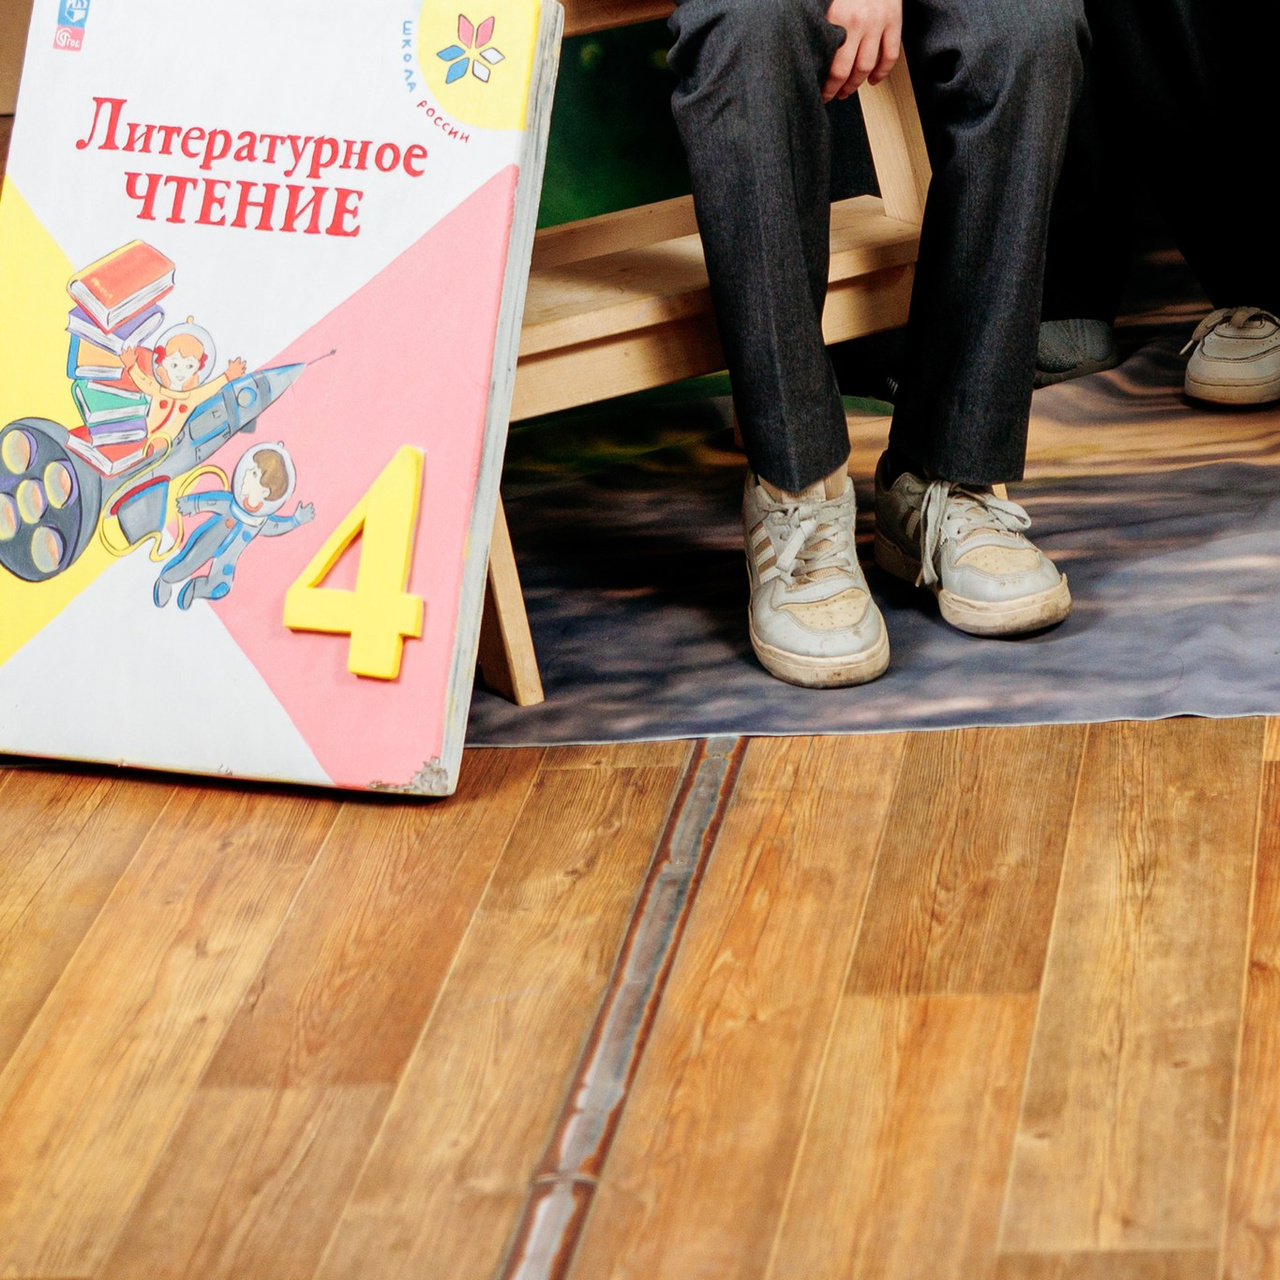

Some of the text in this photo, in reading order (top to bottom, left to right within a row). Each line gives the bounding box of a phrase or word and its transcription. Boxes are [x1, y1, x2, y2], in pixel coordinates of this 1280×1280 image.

[402, 20, 470, 143] ШКОЛА РОССИИ
[75, 96, 429, 180] Литературное
[124, 171, 365, 238] ЧТЕНИЕ
[283, 444, 426, 681] 4
